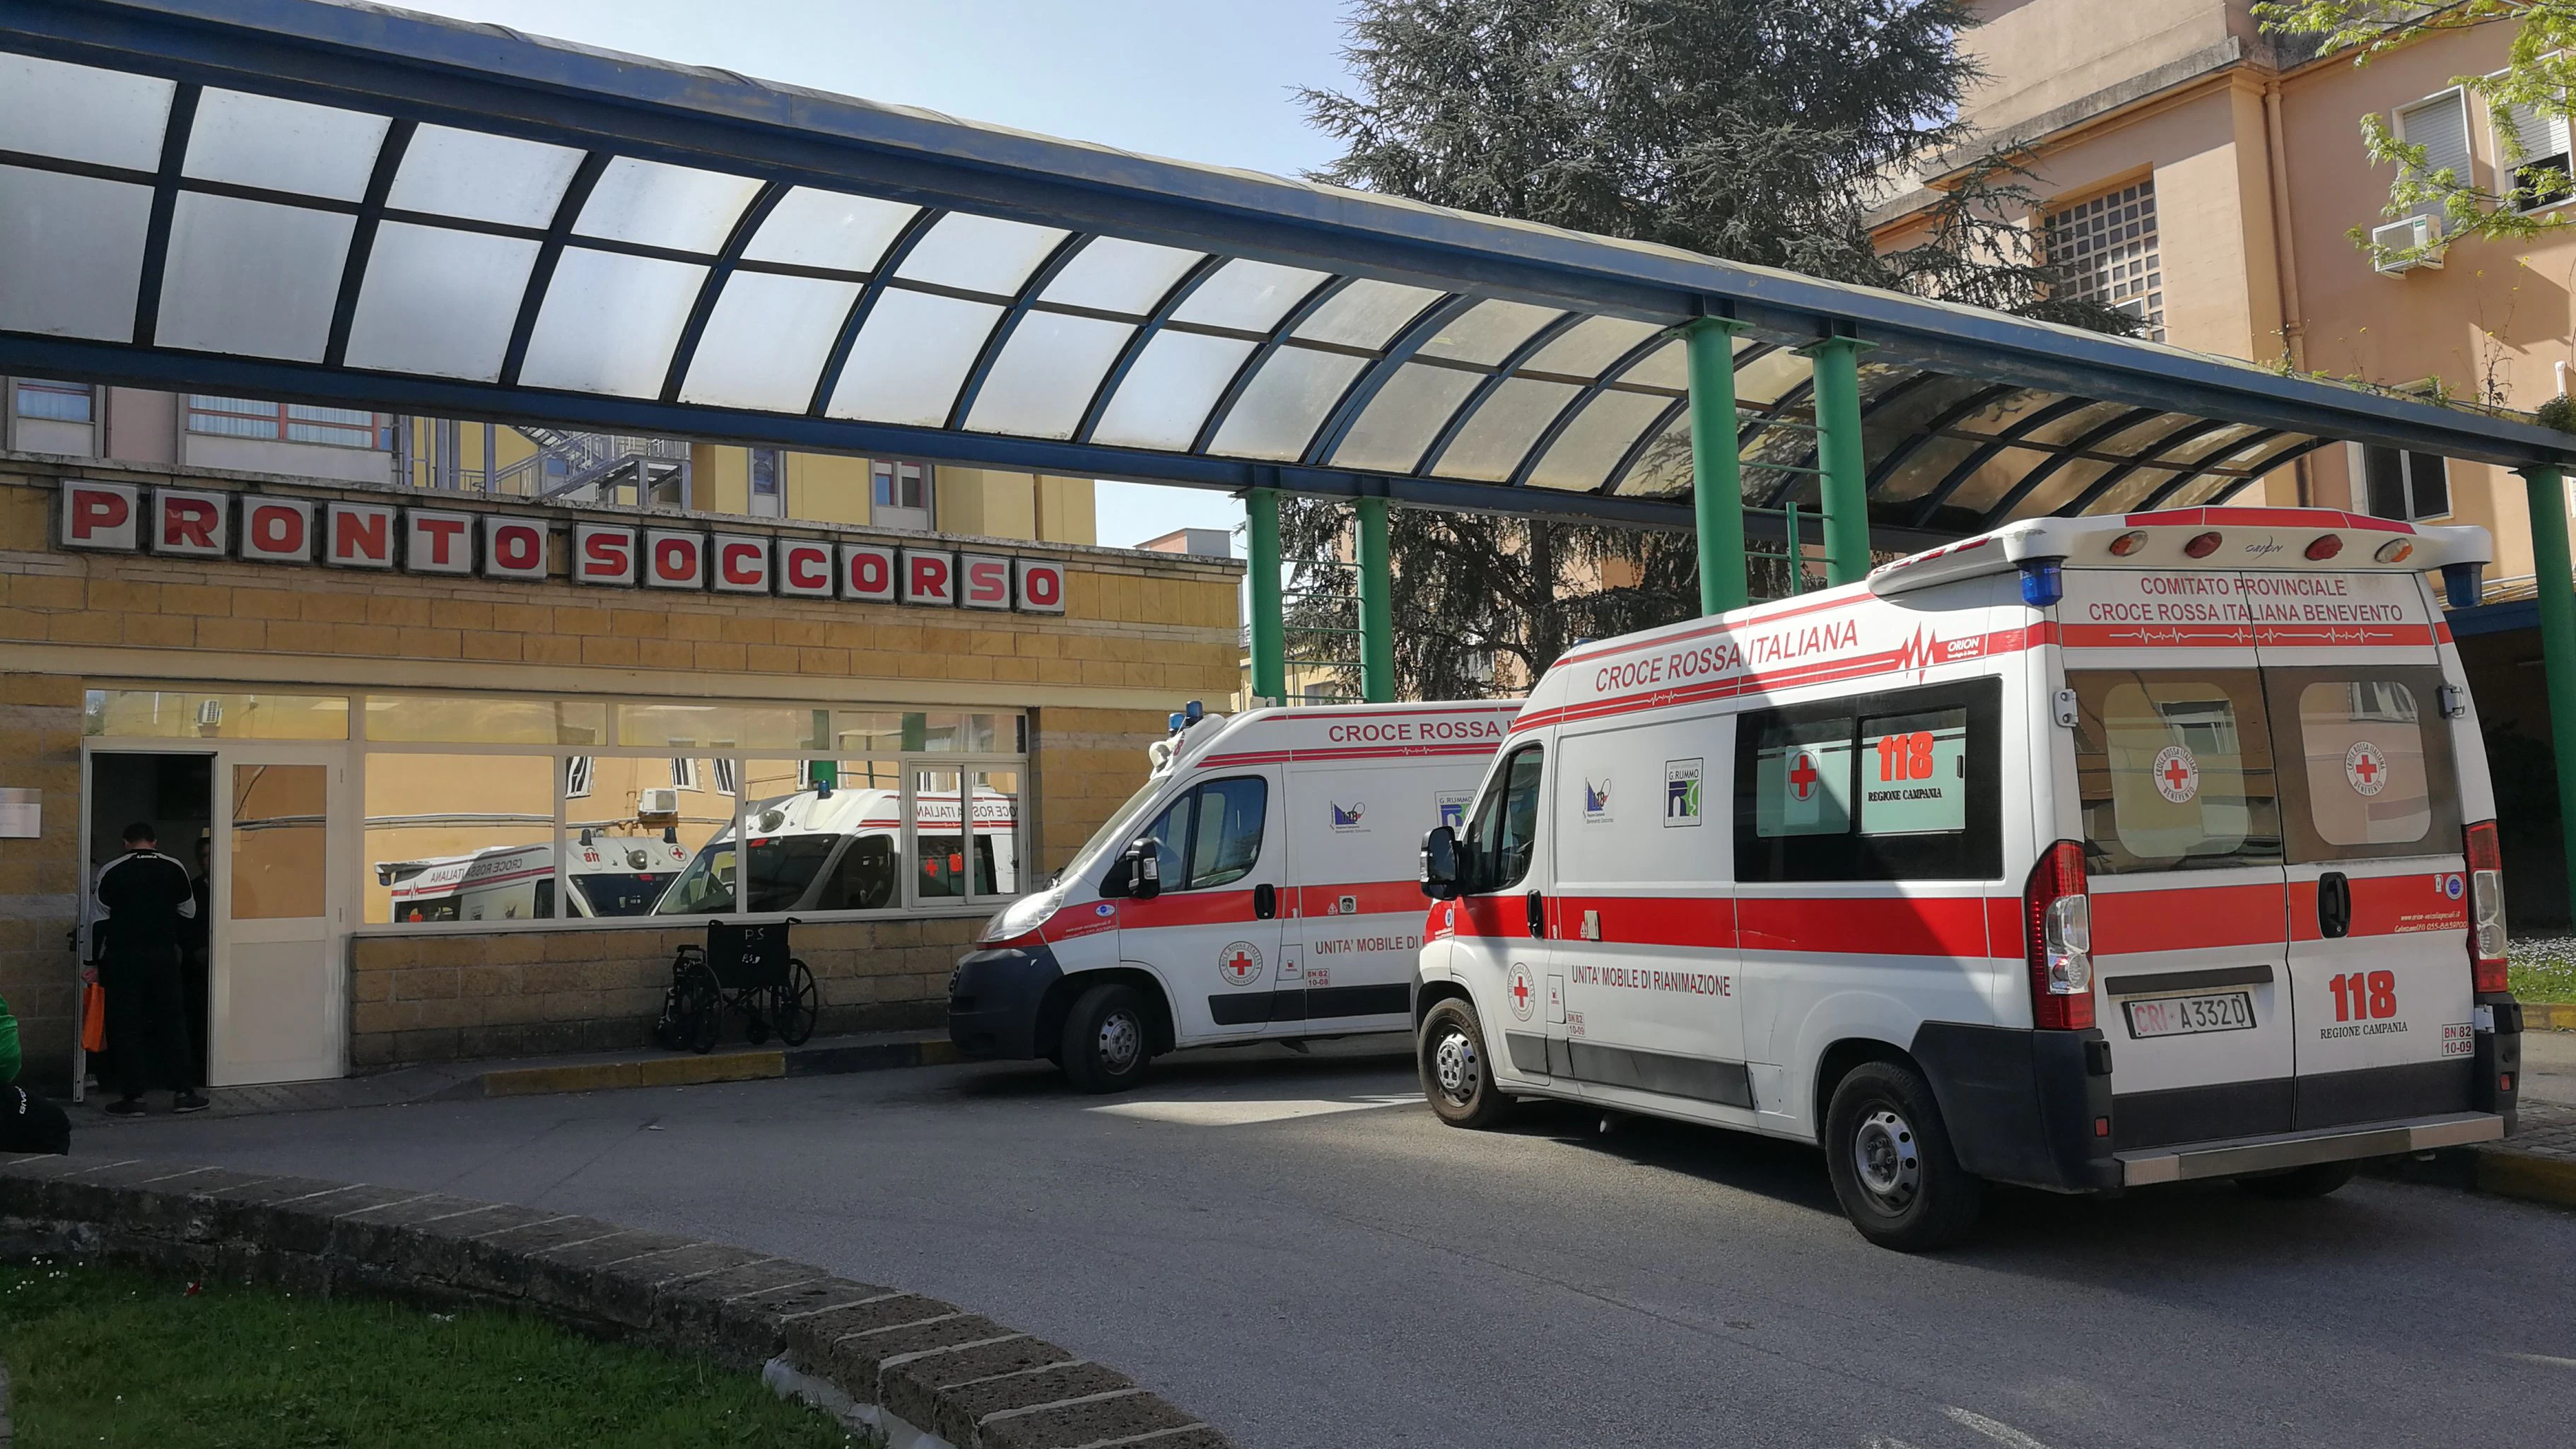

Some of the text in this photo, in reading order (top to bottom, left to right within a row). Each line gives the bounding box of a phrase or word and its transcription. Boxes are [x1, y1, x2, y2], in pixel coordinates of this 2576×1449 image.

[71, 490, 1059, 606] PRONTO SOCCORSO
[2141, 577, 2348, 596] COMITATO PROVINCIALE
[2089, 603, 2403, 622] CROCE ROSSA ITALIANA BENEVENTO
[1948, 637, 1979, 652] ORION
[1596, 619, 1858, 692] CROCE ROSSA ITALIANA
[1329, 723, 1412, 742] CROCE
[1419, 721, 1501, 740] ROSSA
[1878, 731, 1933, 782] 118
[2155, 747, 2198, 776] CROCE ROSSA ITALIANA
[2347, 743, 2387, 770] CROCE ROSSA ITALIANA
[1868, 787, 1943, 802] REGIONE CAMPANIA
[2163, 787, 2195, 802] BENEVENTO
[2353, 780, 2383, 794] BENEVENTO
[1316, 939, 1354, 954] UNITA'
[1357, 937, 1403, 952] MOBILE
[1407, 935, 1419, 949] DI
[1571, 965, 1731, 997] UNITA' MOBILE DI RIANIMAZIONE
[2329, 970, 2397, 1022] 118
[1568, 1013, 1583, 1024] BN 82
[2134, 1004, 2169, 1033] CRI
[2320, 1021, 2408, 1040] REGIONE CAMPANIA
[2444, 1026, 2471, 1039] BN 82
[2445, 1040, 2472, 1054] 10-09
